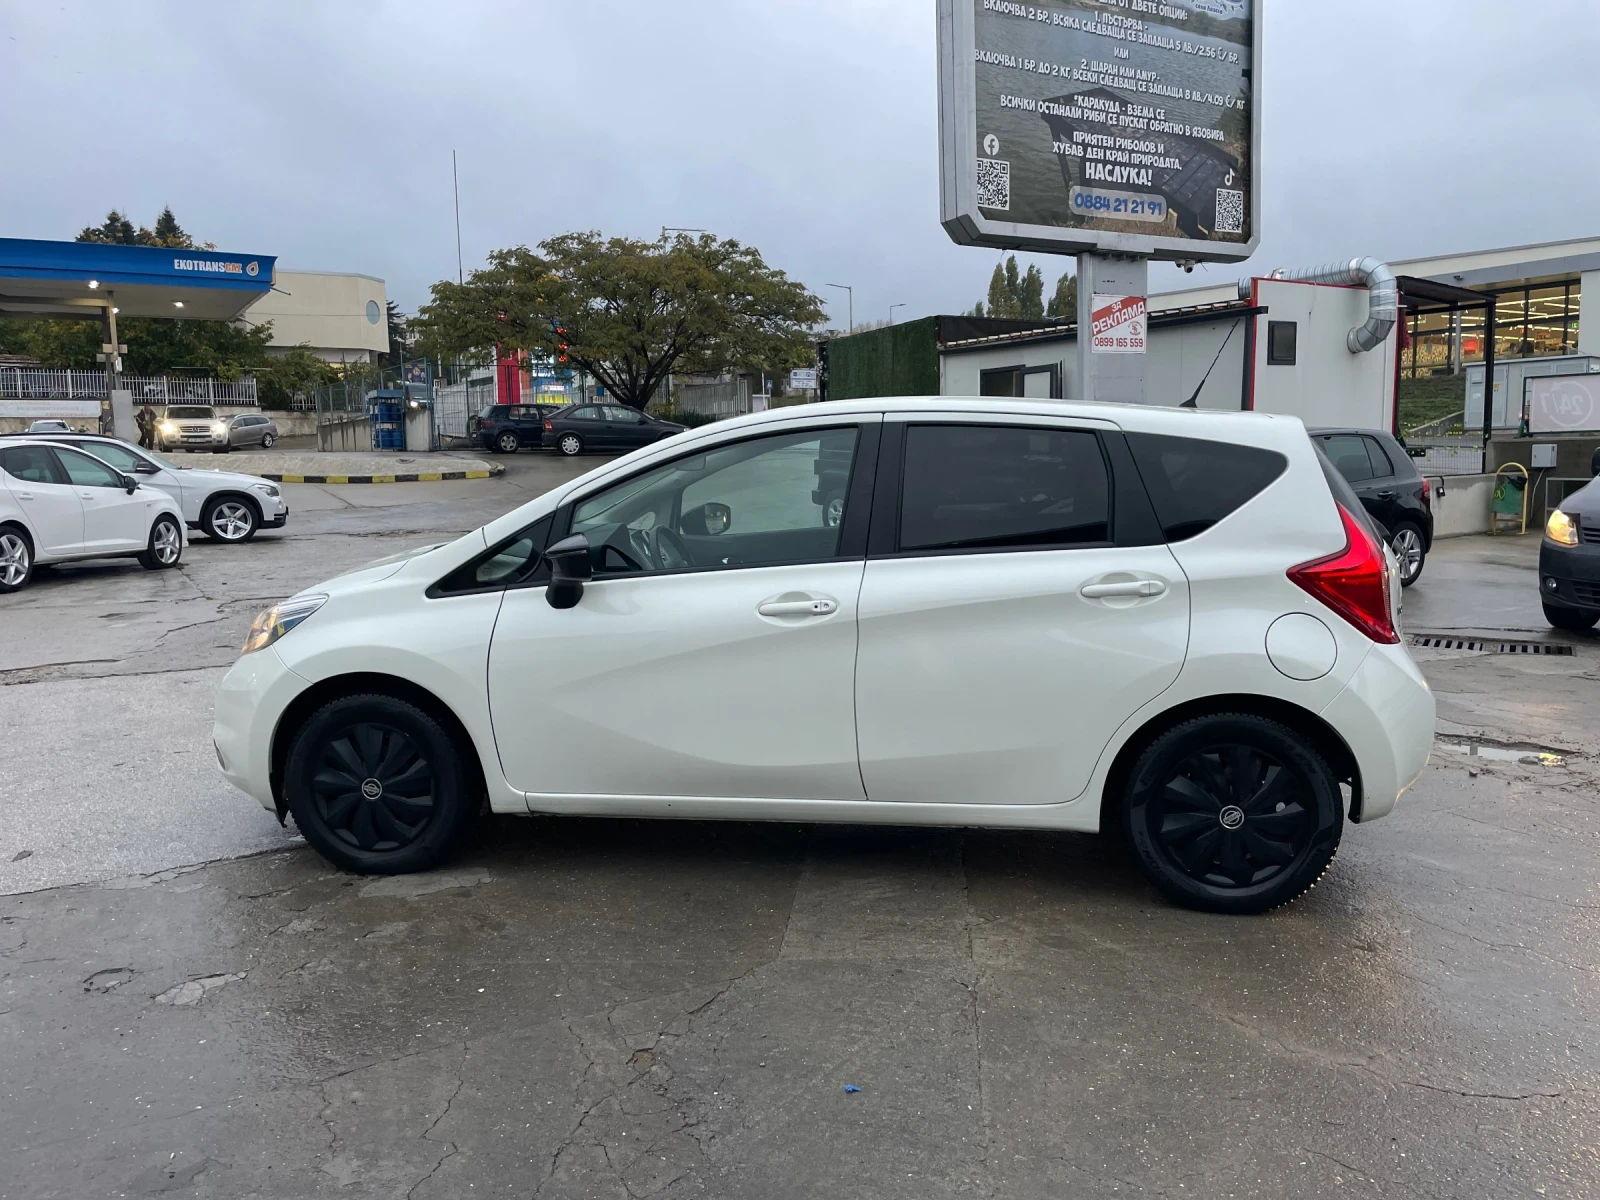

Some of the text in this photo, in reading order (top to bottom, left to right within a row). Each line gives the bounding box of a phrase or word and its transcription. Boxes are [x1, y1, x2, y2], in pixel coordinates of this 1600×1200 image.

[1095, 11, 1100, 22] 1.
[1102, 12, 1142, 30] ПЪСТЪРВА
[1132, 0, 1156, 14] ДВЕТЕ
[1159, 5, 1188, 20] ОПЦИИ:
[984, 0, 1026, 17] ВКЛЮЧВА
[1028, 8, 1034, 19] 2
[1038, 10, 1051, 24] БР.,
[1054, 13, 1080, 30] ВСЯКА
[1082, 20, 1125, 39] СЛЕДВАЩА
[1128, 30, 1136, 40] СЕ
[1139, 34, 1174, 50] ЗАПЛАЩА
[1176, 41, 1181, 50] 5
[1228, 52, 1238, 64] БР.
[1114, 47, 1128, 58] ИЛИ
[1081, 58, 1088, 70] 2.
[1092, 60, 1118, 75] ШАРАН
[1120, 66, 1134, 78] ИЛИ
[975, 49, 1016, 68] ВКЛЮЧВА
[1018, 58, 1022, 68] 1
[1024, 60, 1036, 72] БР.
[1038, 62, 1050, 74] ДО
[1052, 65, 1058, 76] 2
[1060, 66, 1070, 79] КГ,
[1073, 69, 1098, 83] ВСЕКИ
[1100, 74, 1136, 91] СЛЕДВАЩ
[1138, 81, 1146, 92] СЕ
[1148, 82, 1184, 98] ЗАПЛАЩА
[1185, 90, 1190, 100] 8
[1236, 100, 1245, 110] КГ
[1000, 94, 1224, 141] ВСИЧКИ ОСТАНАЛИ РИБИ СЕ ПУСКАТ ОБРАТНО В ЯЗОВИРА
[1128, 104, 1154, 118] ВЗЕМА
[1156, 109, 1165, 120] СЕ
[1052, 141, 1084, 156] ХУБАВ
[1086, 146, 1104, 160] ДЕН
[1106, 150, 1129, 163] КРАЙ
[1073, 132, 1164, 154] ПРИЯТЕН РИБОЛОВ И
[1086, 162, 1152, 186] НАСЛУКА!
[1074, 192, 1162, 216] 0884 21 21 91
[1092, 301, 1146, 334] РЕКЛАМА
[1112, 302, 1122, 312] ЗА
[1094, 337, 1144, 348] 0899 165 559
